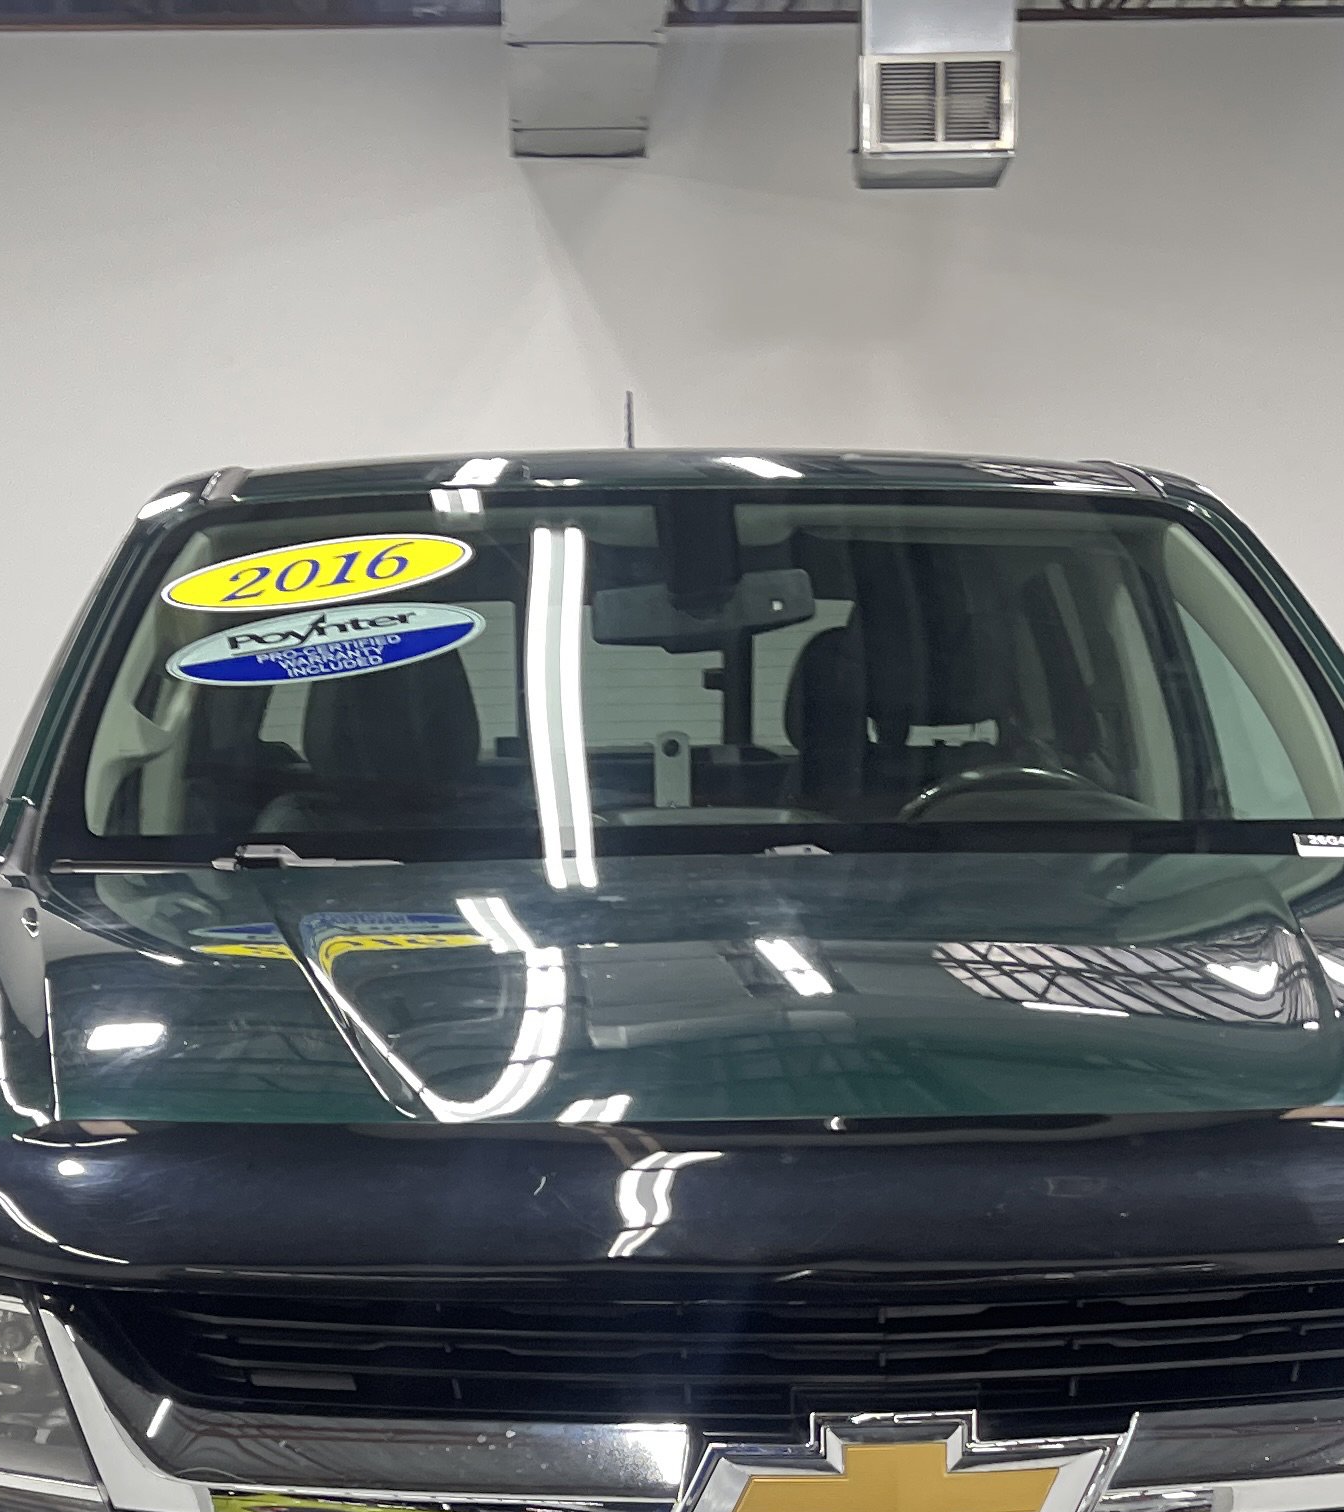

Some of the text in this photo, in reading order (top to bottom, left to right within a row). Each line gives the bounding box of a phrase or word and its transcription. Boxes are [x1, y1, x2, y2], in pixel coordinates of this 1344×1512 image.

[221, 541, 415, 602] 2016
[227, 612, 417, 656] Poynter
[286, 655, 384, 678] INCLUDED
